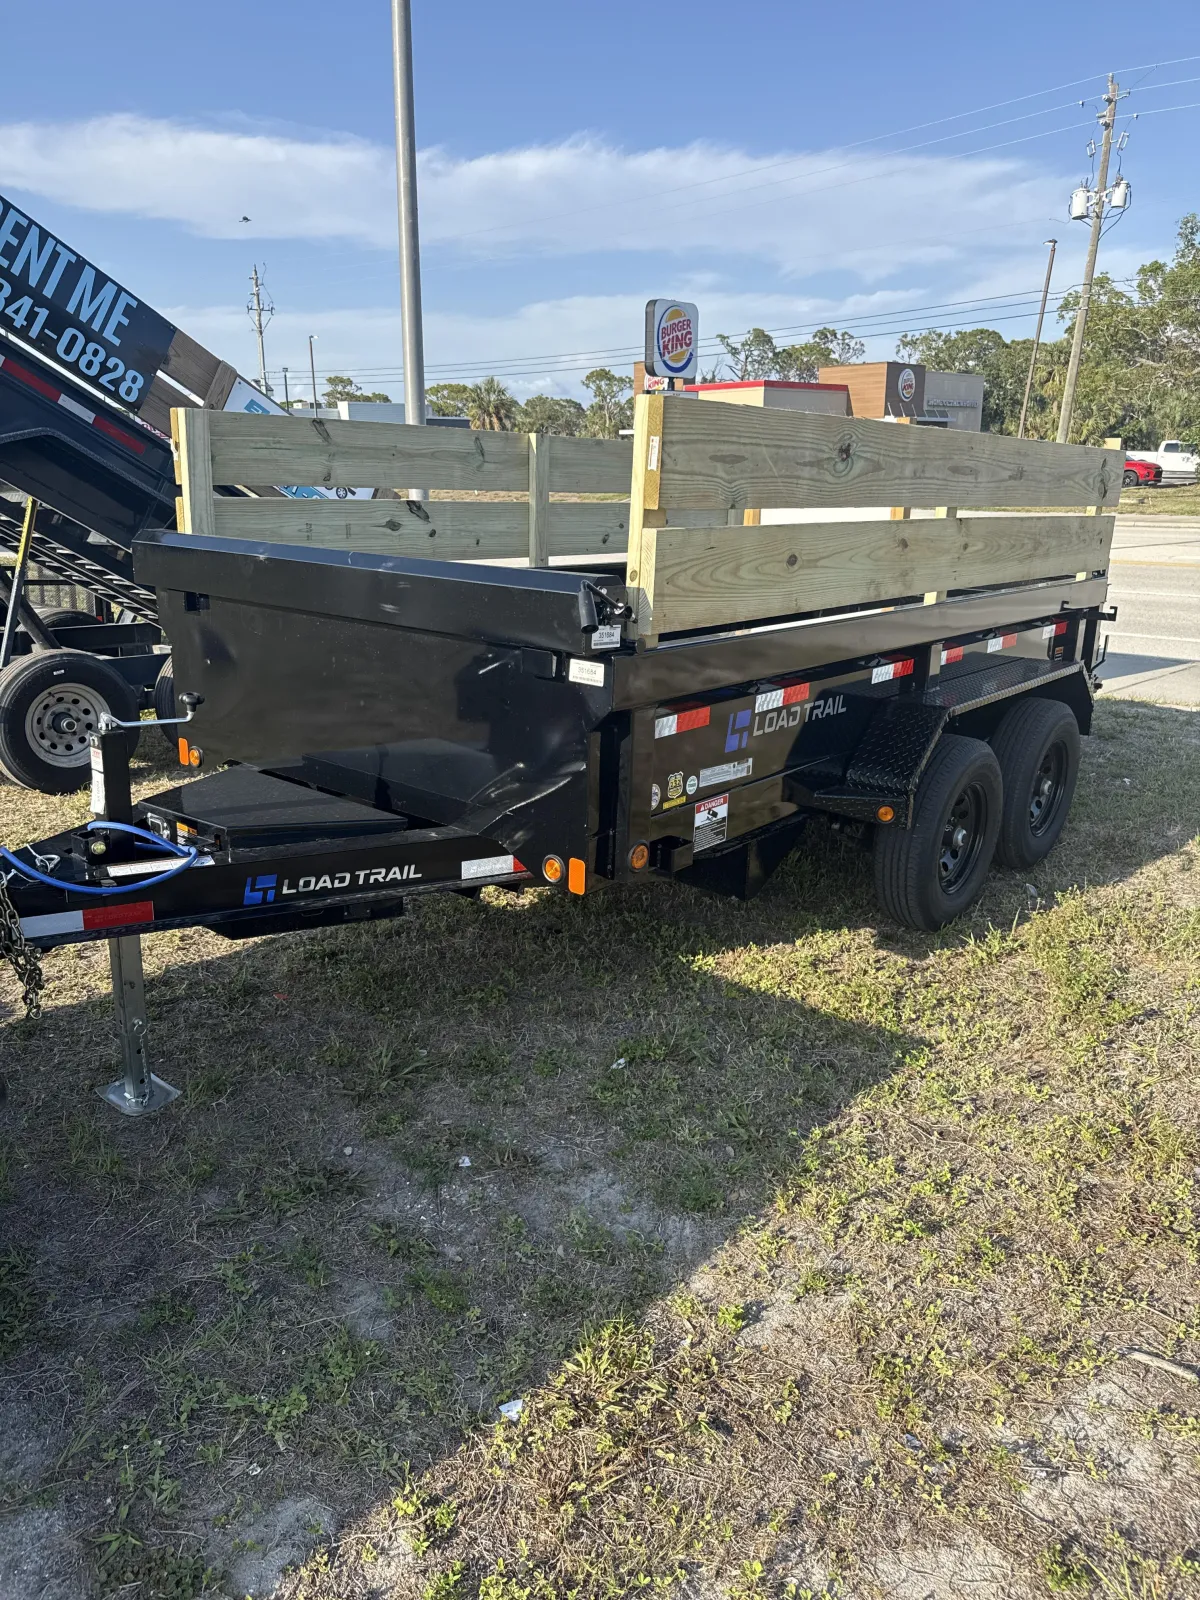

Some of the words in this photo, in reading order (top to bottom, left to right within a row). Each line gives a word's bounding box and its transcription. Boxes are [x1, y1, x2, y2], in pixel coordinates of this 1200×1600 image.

[0, 202, 77, 299] ENT
[66, 264, 138, 347] ME
[661, 319, 692, 340] BURGER
[661, 330, 693, 358] KING
[753, 706, 801, 737] LOAD
[804, 694, 847, 722] TRAIL
[282, 872, 351, 895] LOAD
[355, 864, 423, 885] TRAIL
